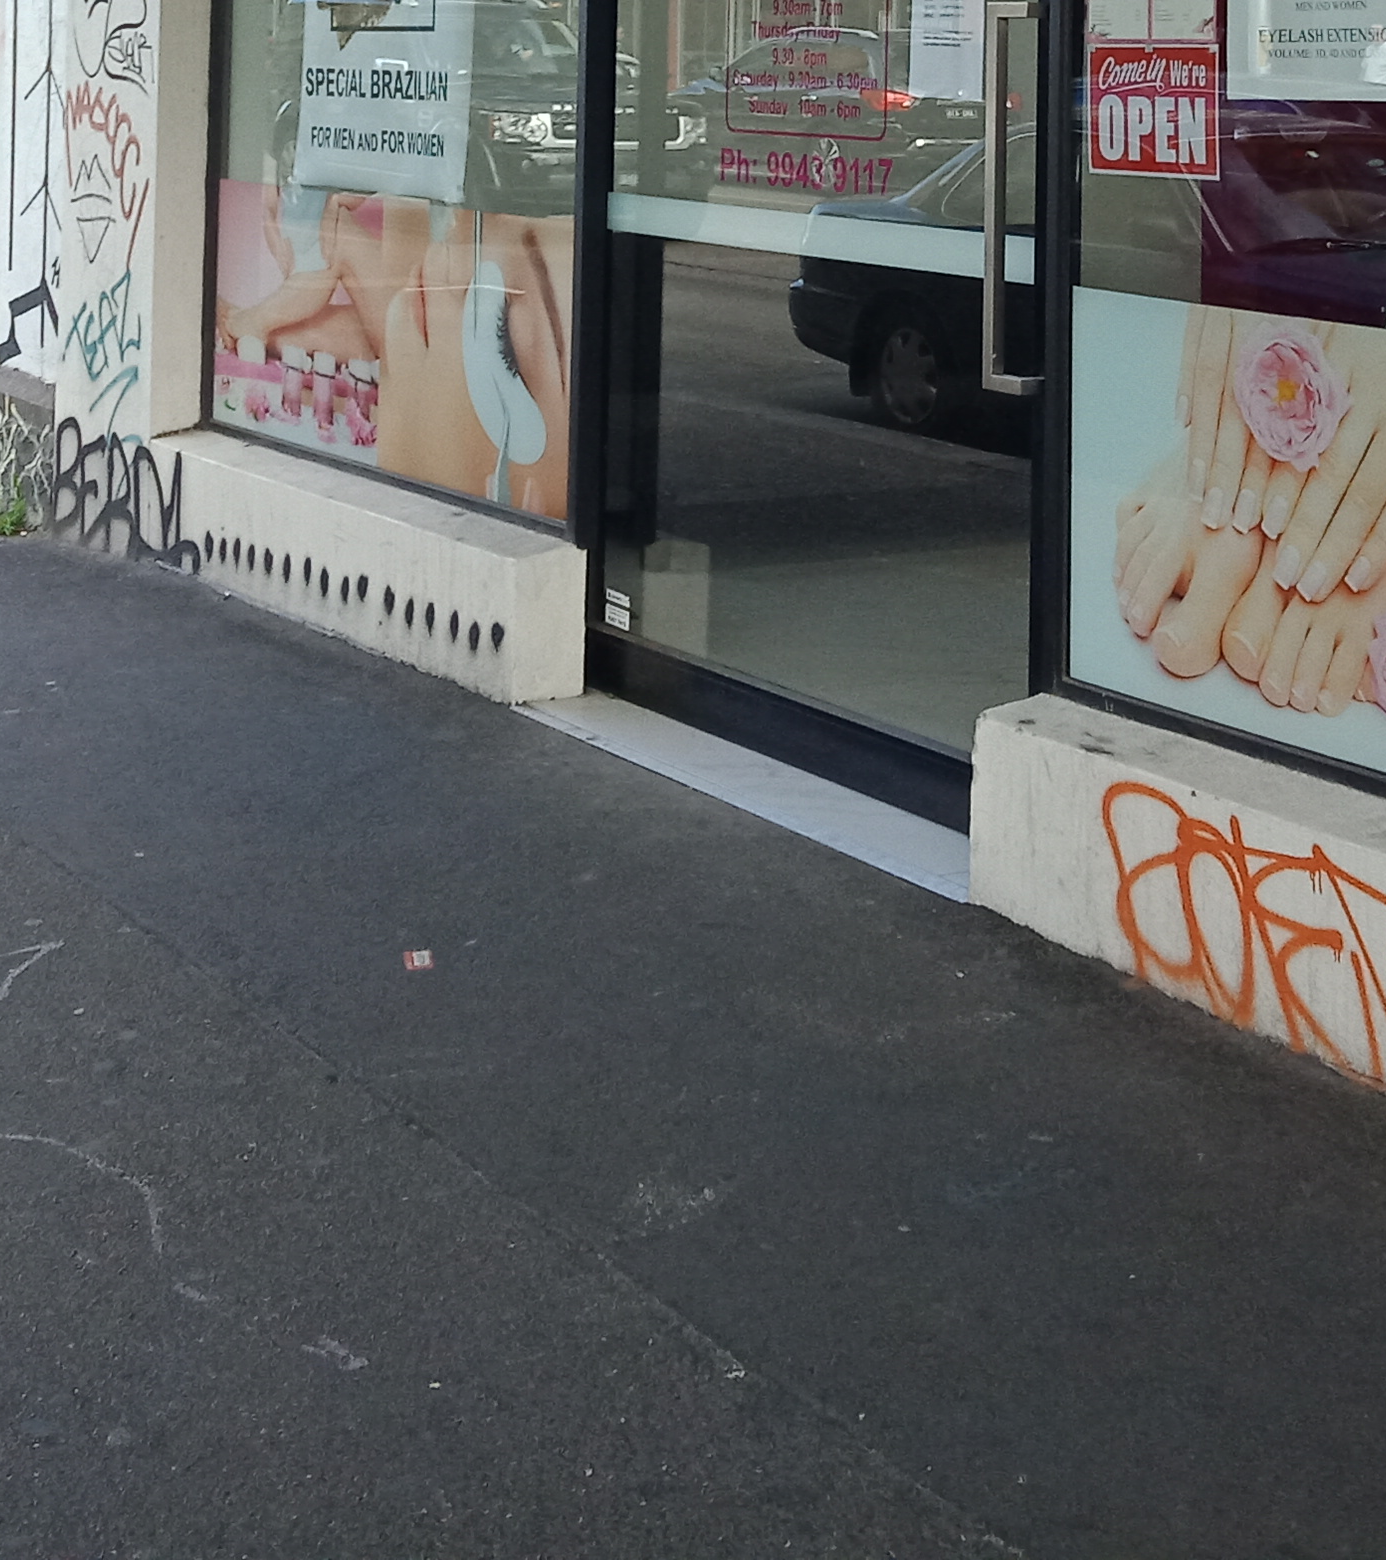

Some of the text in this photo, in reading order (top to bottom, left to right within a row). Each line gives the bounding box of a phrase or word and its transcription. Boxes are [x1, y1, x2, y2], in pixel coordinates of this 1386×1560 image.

[1258, 27, 1324, 44] EYELASH
[305, 67, 449, 102] SPECIAL BRAZILIAN
[1098, 53, 1206, 92] Come in We're
[748, 99, 789, 117] Sunday
[837, 101, 862, 122] 6pm
[311, 126, 445, 157] FOR MEN AND FOR WOMEN
[1098, 94, 1208, 165] OPEN
[720, 147, 758, 184] Ph:
[832, 156, 894, 196] 9117
